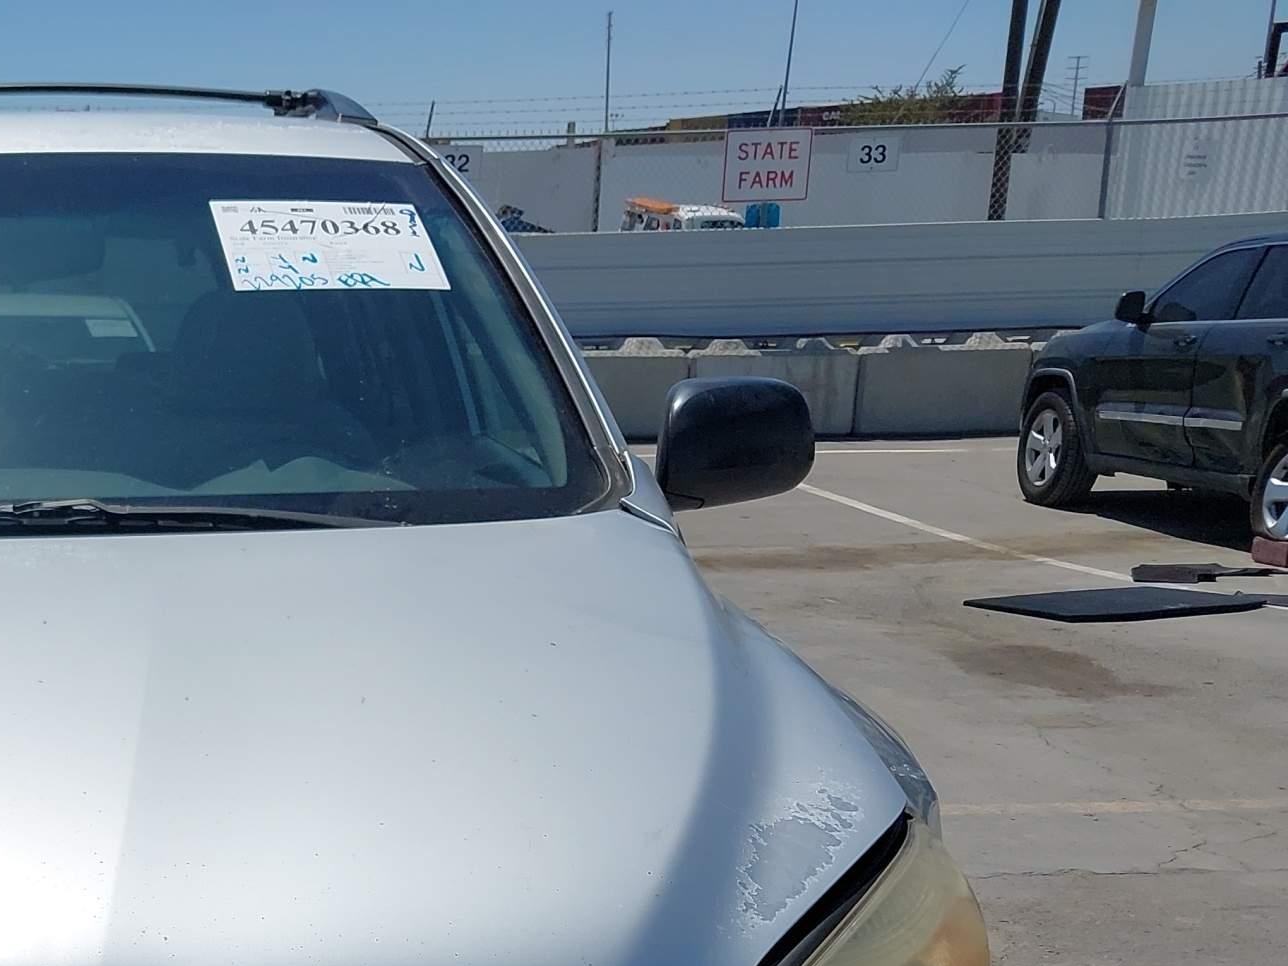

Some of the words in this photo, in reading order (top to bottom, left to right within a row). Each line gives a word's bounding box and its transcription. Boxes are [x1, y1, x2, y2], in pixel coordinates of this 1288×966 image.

[737, 142, 800, 160] STATE
[859, 145, 887, 164] 33
[737, 170, 794, 189] FARM
[240, 219, 401, 236] 45470368
